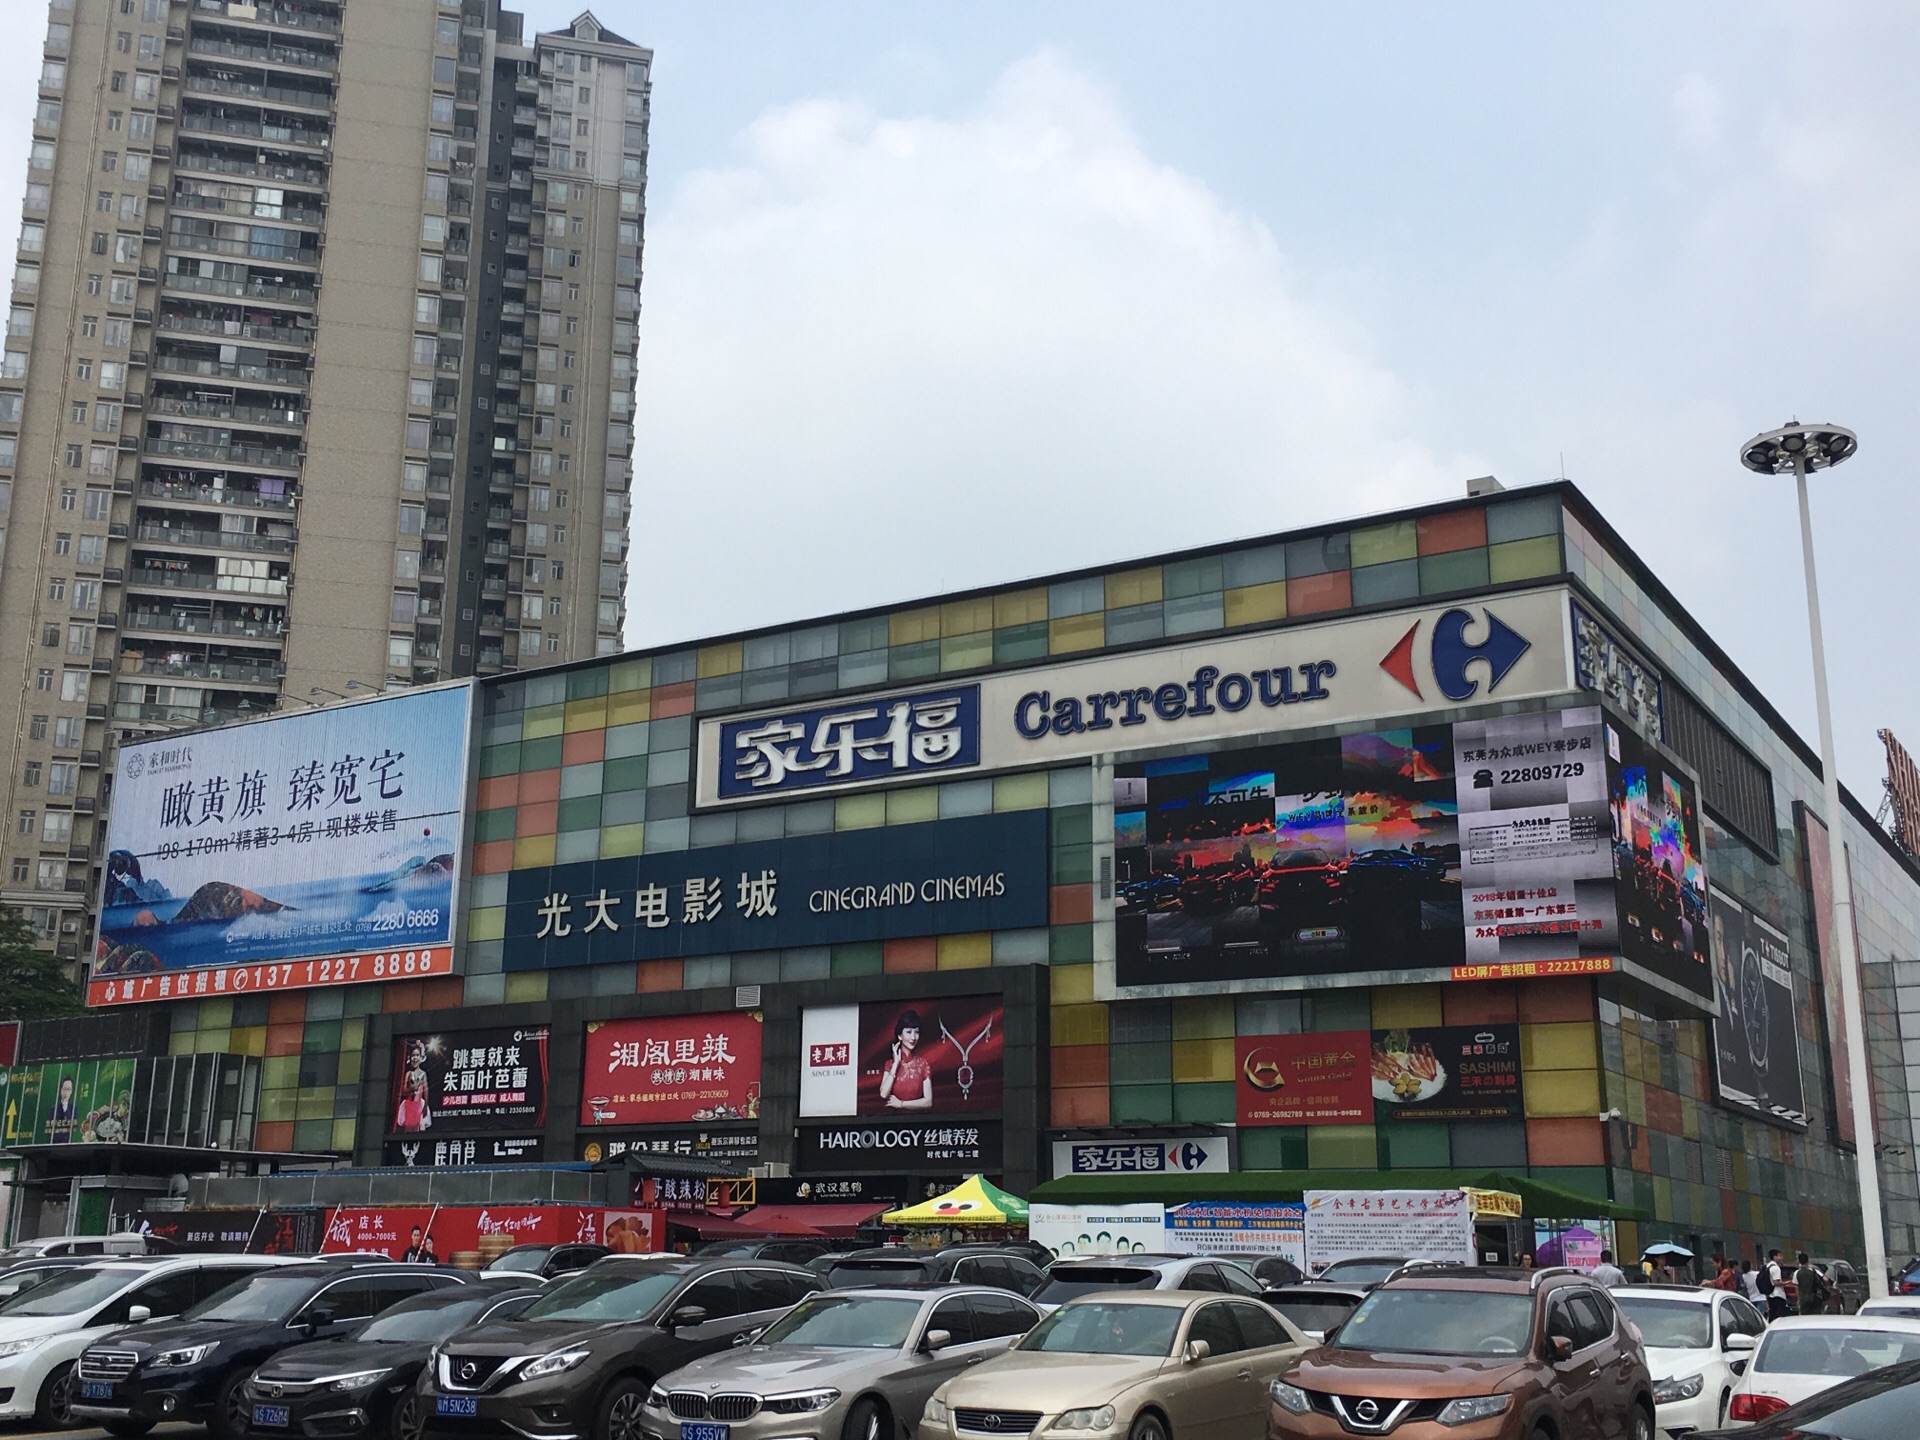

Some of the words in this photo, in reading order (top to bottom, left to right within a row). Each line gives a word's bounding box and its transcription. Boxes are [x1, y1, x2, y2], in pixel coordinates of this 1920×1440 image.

[1013, 657, 1337, 740] Carrefour
[735, 697, 962, 787] 家乐福
[1501, 763, 1584, 785] 22809729
[159, 769, 268, 829] 瞰黄旗
[286, 749, 406, 812] 臻宽宅
[536, 870, 778, 939] 光大电影城
[808, 881, 915, 913] CINEGRAND
[920, 873, 1005, 903] CINEMAS
[372, 911, 404, 931] 2280
[407, 908, 439, 928] 6666
[1769, 944, 1789, 968] TISSOT
[254, 964, 292, 988] 137
[306, 958, 361, 982] 1227
[373, 950, 432, 976] 8888
[452, 1046, 521, 1070] 跳舞就来
[608, 1033, 737, 1073] 湘阁里辣
[1291, 1051, 1356, 1070] 中国黄金
[443, 1067, 528, 1092] 朱丽叶芭蕾
[689, 1068, 726, 1081] 湖南味
[1459, 1061, 1516, 1074] SASHIMI
[820, 1129, 922, 1149] HAIROLOGY
[924, 1128, 979, 1146] 丝域养发
[1077, 1145, 1162, 1172] 家乐福
[815, 1182, 862, 1194] 武汉黑鸭
[358, 1215, 384, 1230] 店长
[187, 1231, 215, 1242] 新店开业
[220, 1231, 249, 1242] 敬请期待
[357, 1232, 397, 1241] 4000-7000元
